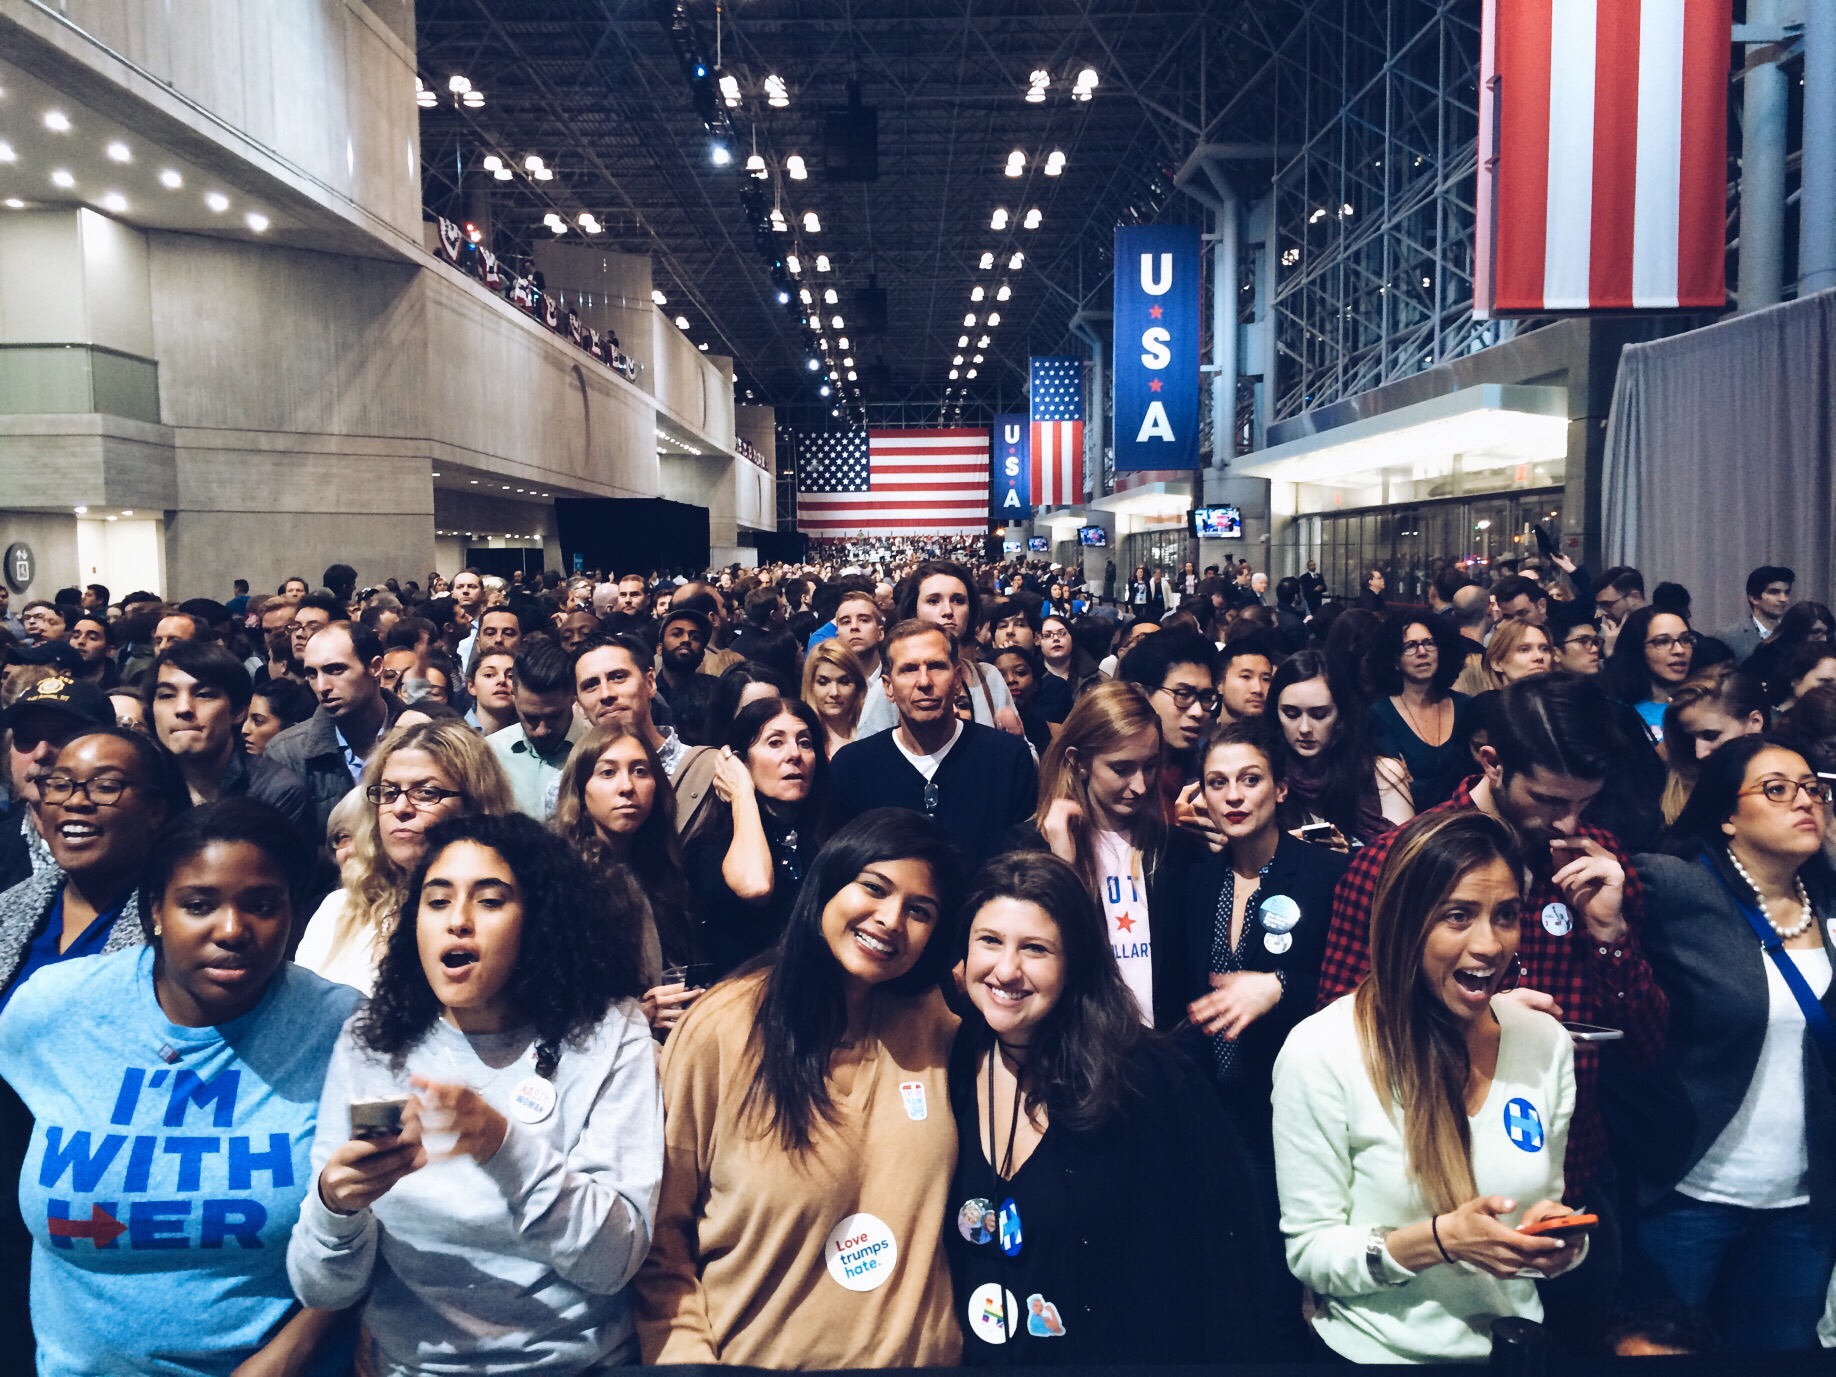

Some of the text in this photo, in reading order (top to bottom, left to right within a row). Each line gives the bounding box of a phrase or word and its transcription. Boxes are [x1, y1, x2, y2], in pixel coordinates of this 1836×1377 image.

[1135, 252, 1176, 443] USA
[1003, 424, 1021, 508] USA
[1106, 875, 1138, 904] OT
[110, 1066, 242, 1128] I'M
[516, 1095, 543, 1113] WOMAN
[38, 1126, 295, 1193] WITH
[46, 1197, 268, 1251] HER
[835, 1233, 868, 1252] Love
[840, 1239, 889, 1265] trumps
[844, 1259, 882, 1279] hate.
